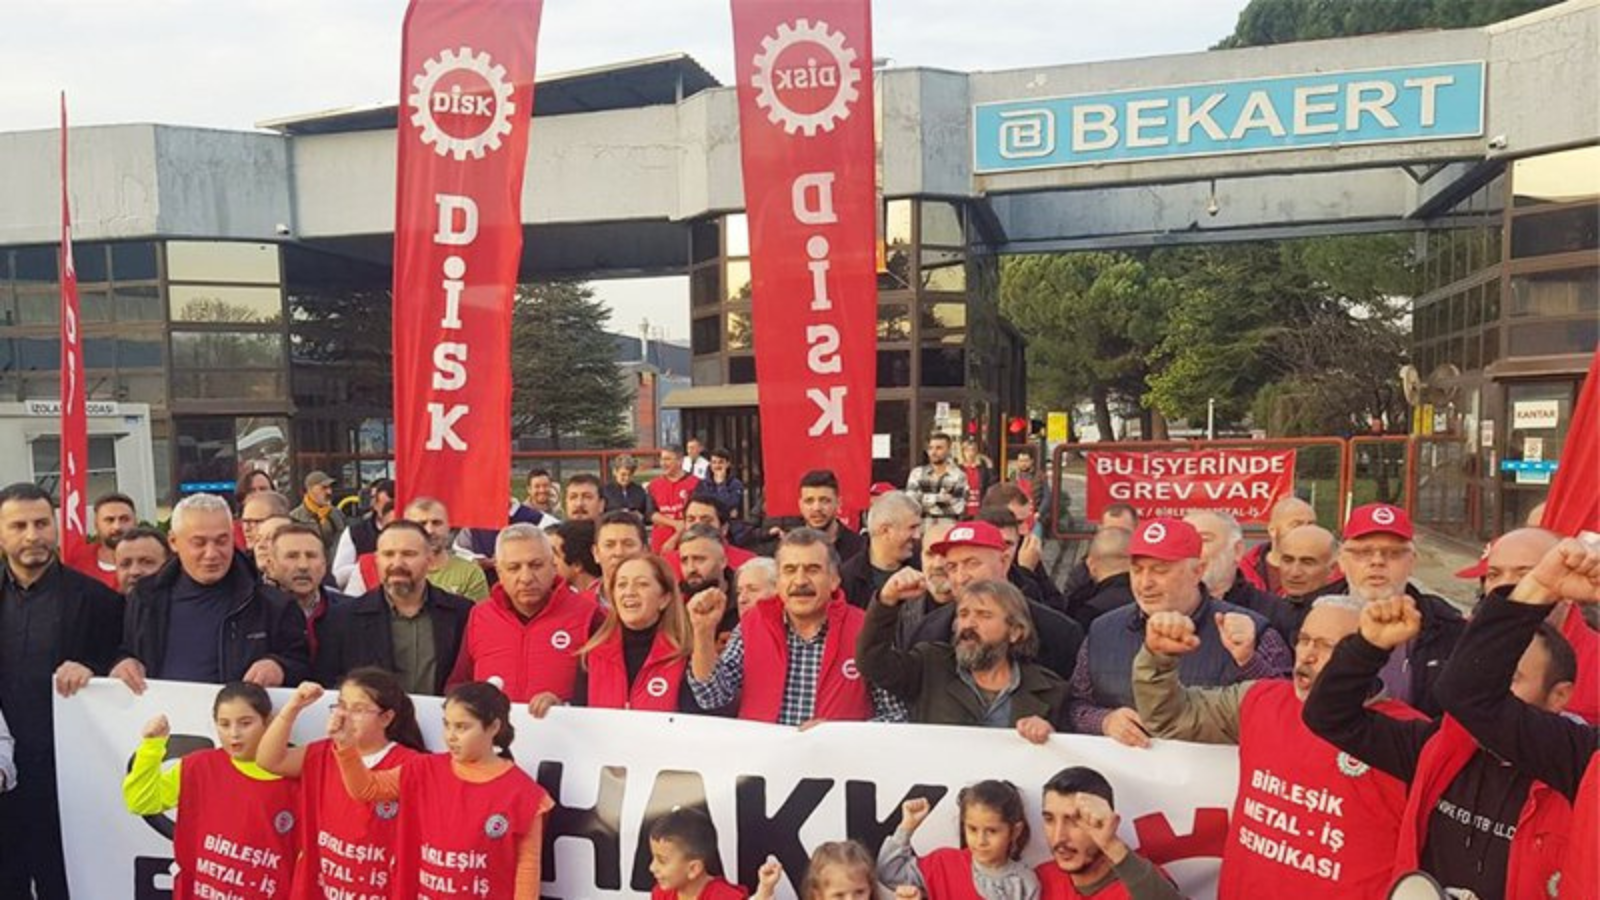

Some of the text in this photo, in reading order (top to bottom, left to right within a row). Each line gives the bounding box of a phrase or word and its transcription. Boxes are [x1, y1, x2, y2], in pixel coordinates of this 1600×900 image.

[433, 84, 493, 117] DİSK
[1071, 75, 1454, 153] BEKAERT
[425, 193, 479, 451] DİSK
[1517, 409, 1555, 419] KANTAR
[1097, 452, 1285, 479] BU İŞYERİNDE
[1109, 481, 1269, 499] GREV VAR
[1251, 769, 1344, 817] BİRLEŞİK
[538, 760, 966, 900] HAKK
[1243, 797, 1300, 836] METAL
[1320, 821, 1345, 853] İŞ
[204, 834, 281, 869] BİRLEŞİK
[1239, 825, 1341, 881] SENDİKASI
[196, 858, 245, 887] METAL
[260, 875, 277, 899] İŞ
[321, 857, 354, 883] ETAL
[369, 867, 388, 889] İŞ
[473, 876, 490, 899] İŞ
